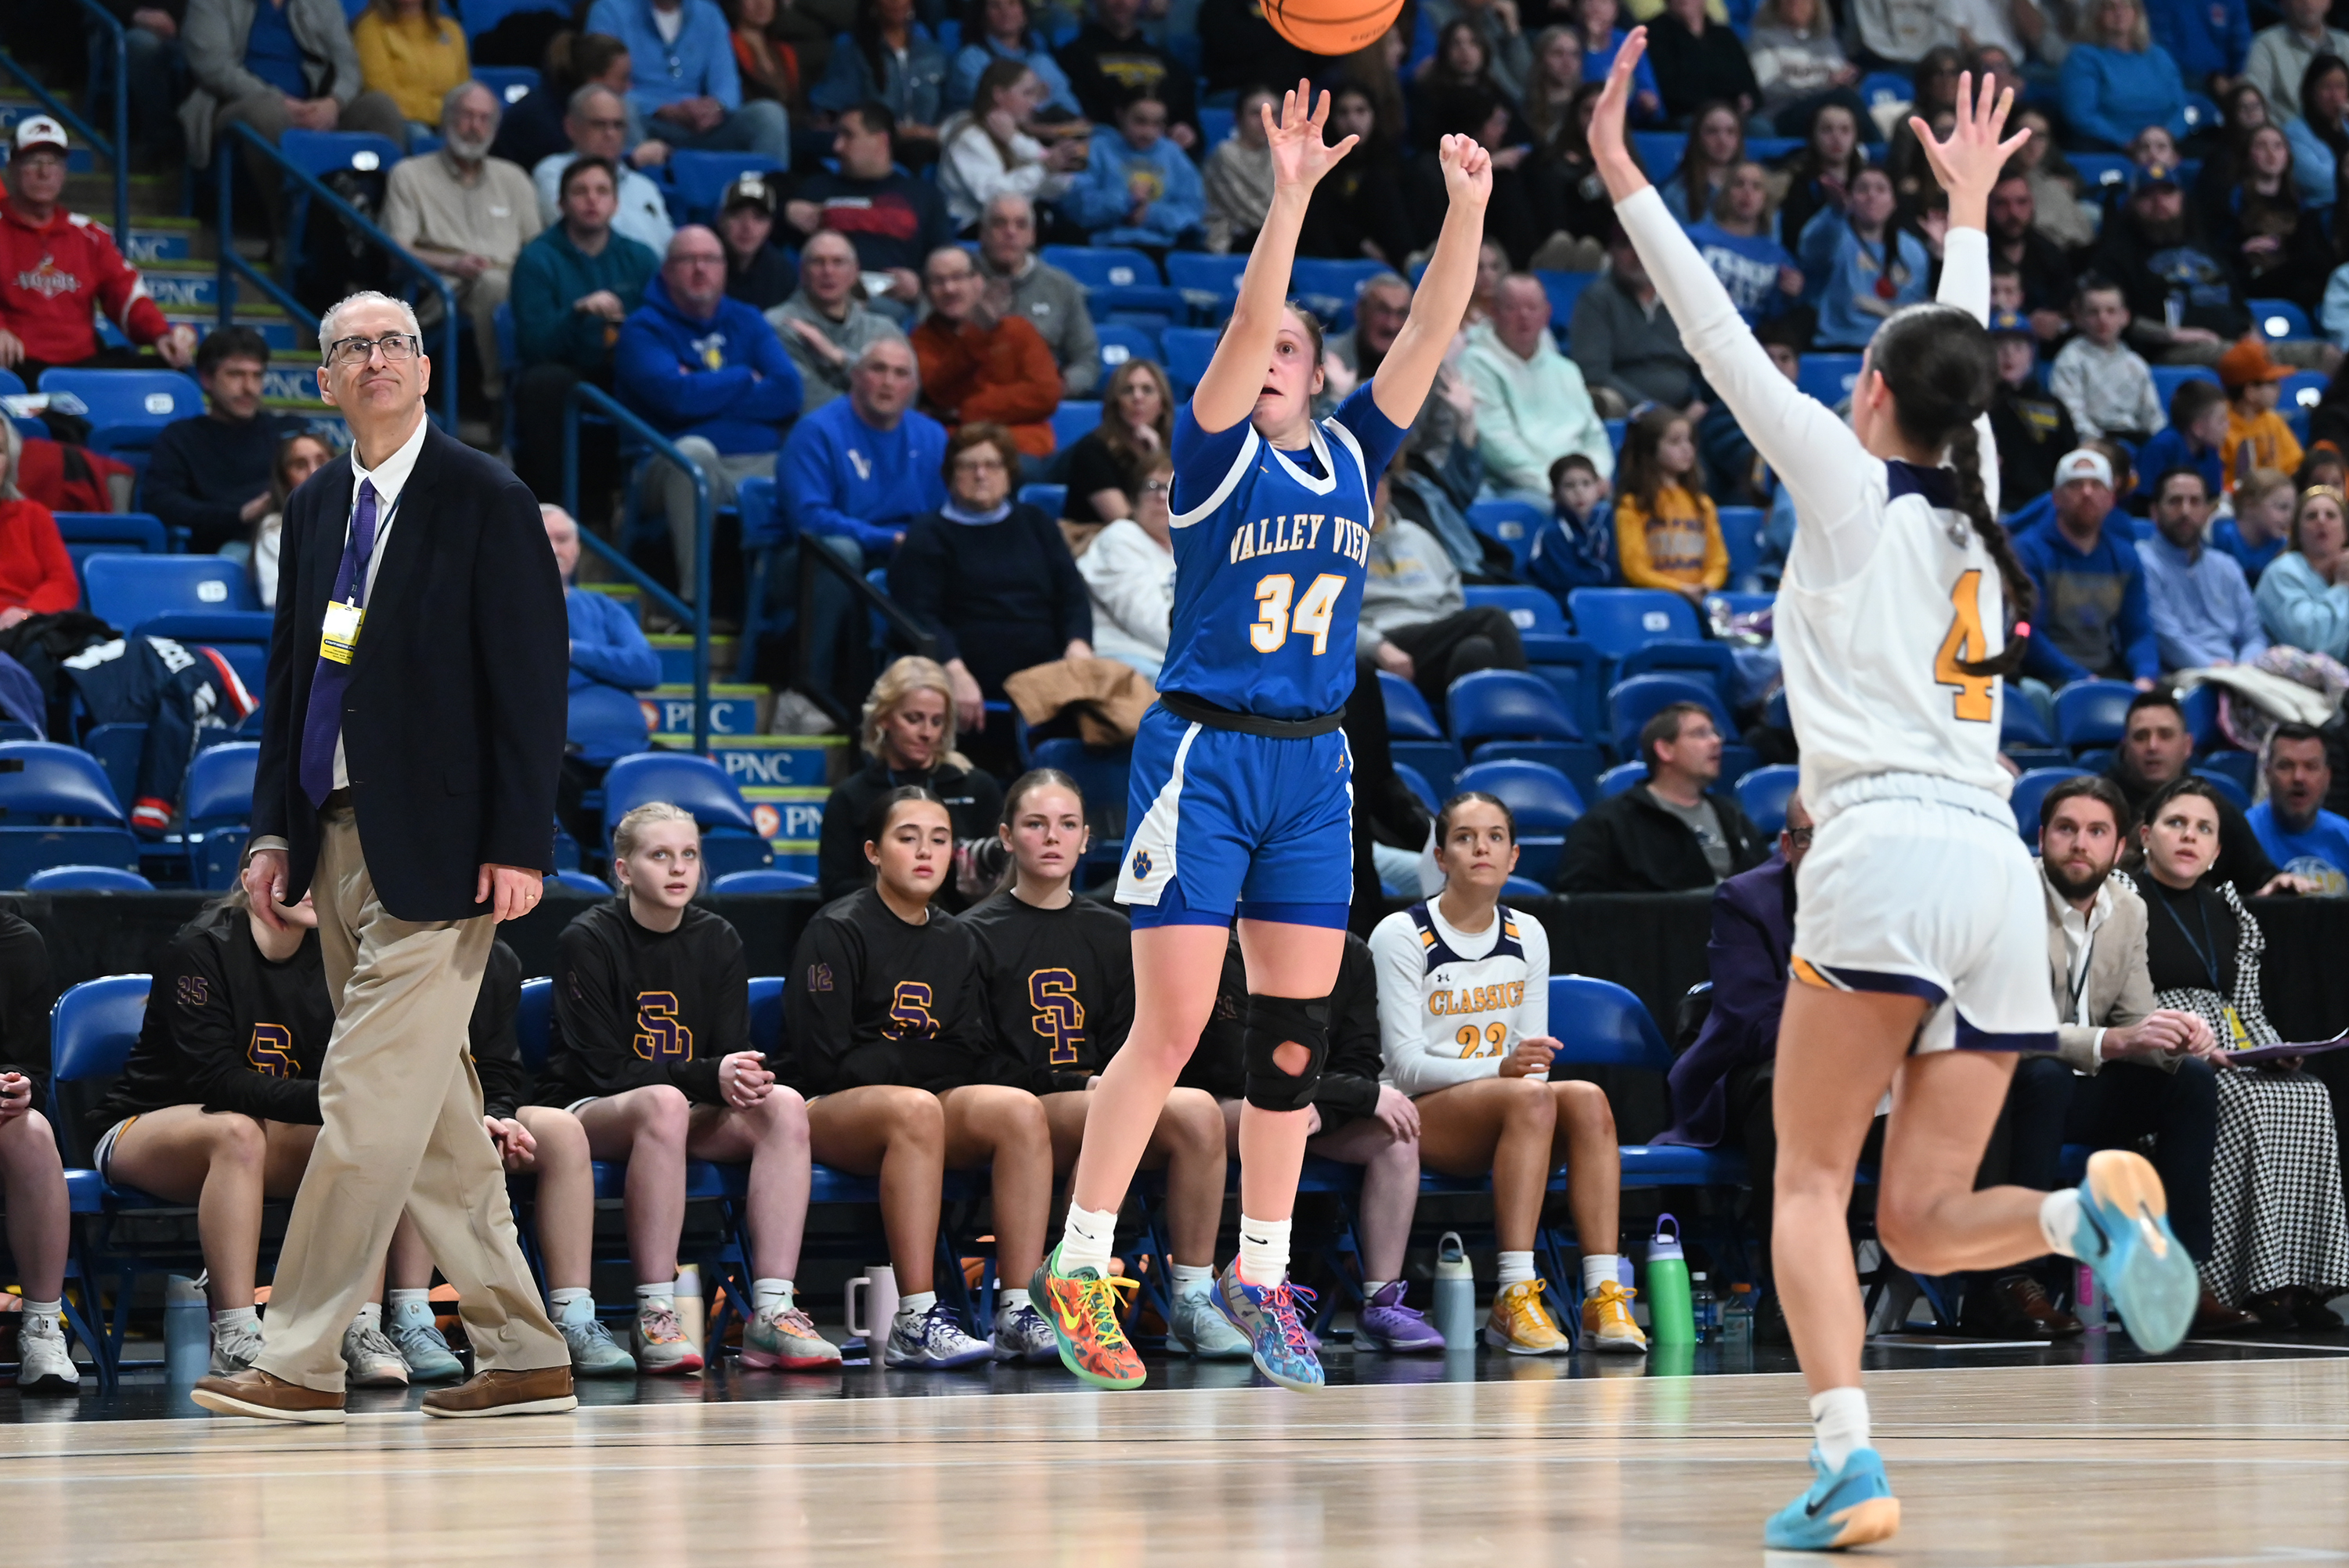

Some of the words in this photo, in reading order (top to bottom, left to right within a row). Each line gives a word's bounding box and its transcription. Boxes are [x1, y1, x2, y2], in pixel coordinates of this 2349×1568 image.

[1230, 514, 1326, 564] VALLEY
[1250, 573, 1348, 655] 34
[1933, 568, 1994, 723] 4
[723, 752, 793, 784] PNC
[785, 805, 823, 837] PN
[177, 975, 208, 1005] 25
[807, 963, 833, 992] 12
[1429, 980, 1525, 1016] CLASSICS
[1456, 1022, 1506, 1059] 23
